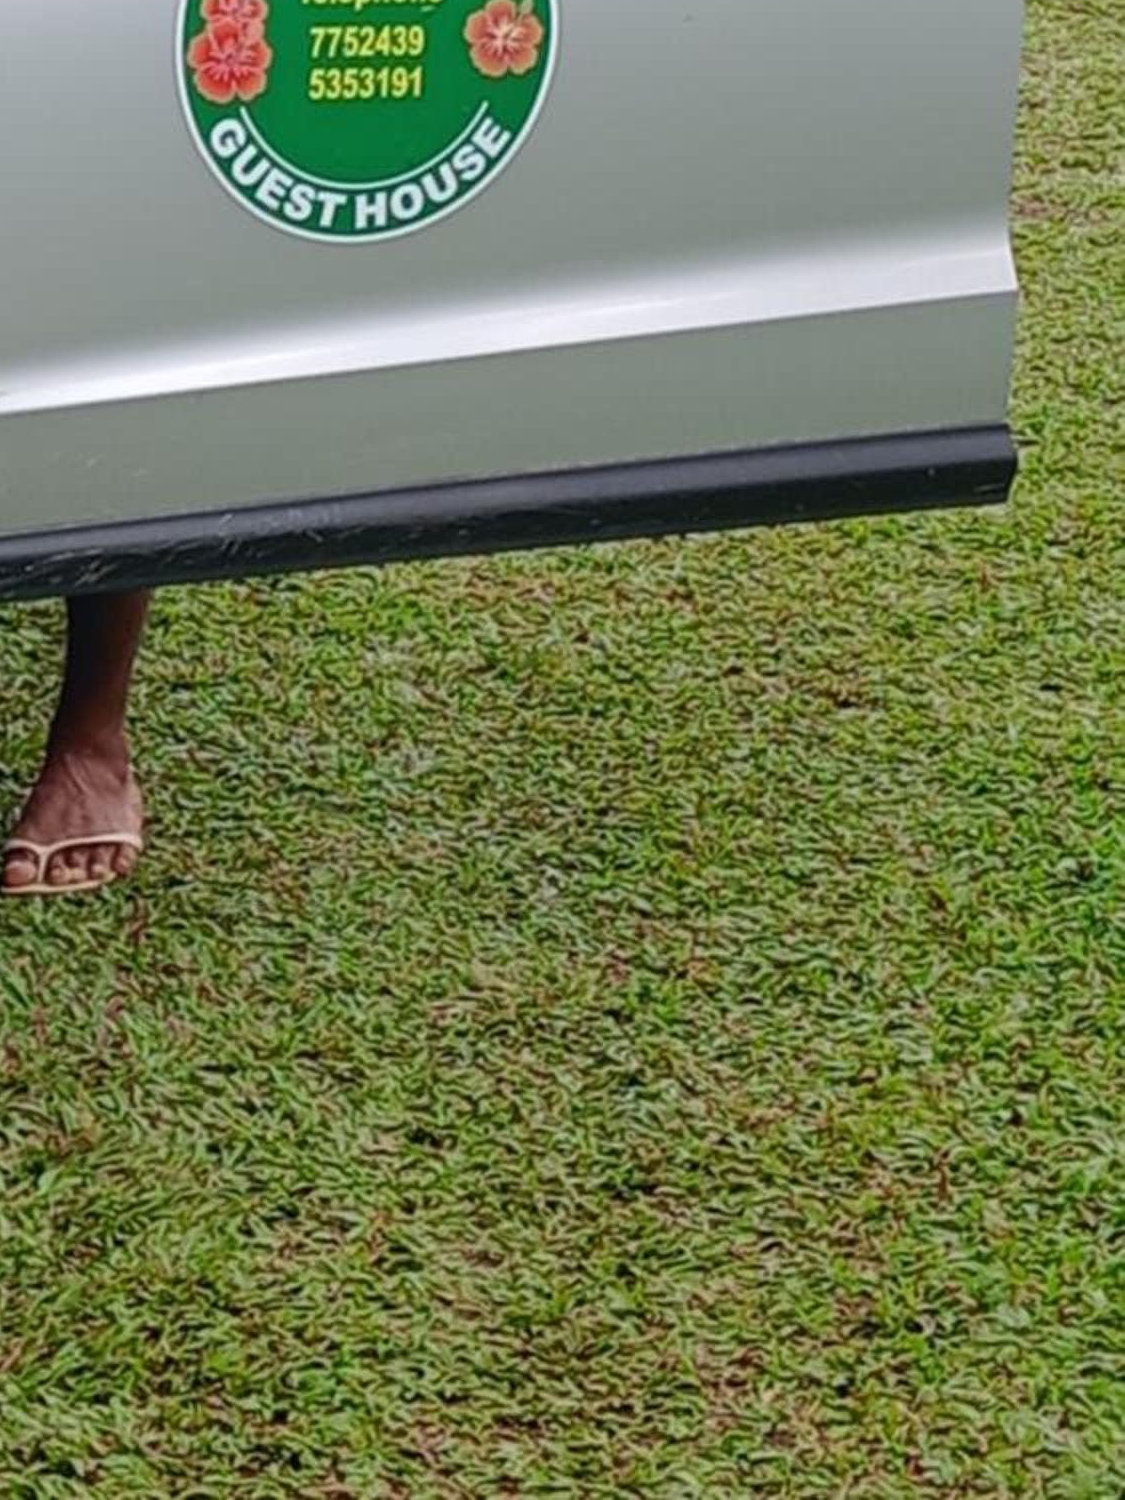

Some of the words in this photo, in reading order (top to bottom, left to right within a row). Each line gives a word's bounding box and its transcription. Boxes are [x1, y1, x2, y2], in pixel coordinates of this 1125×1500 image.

[309, 24, 425, 59] 7752439
[308, 65, 423, 100] 5353191
[210, 118, 347, 228] GUEST
[355, 116, 512, 229] HOUSE
